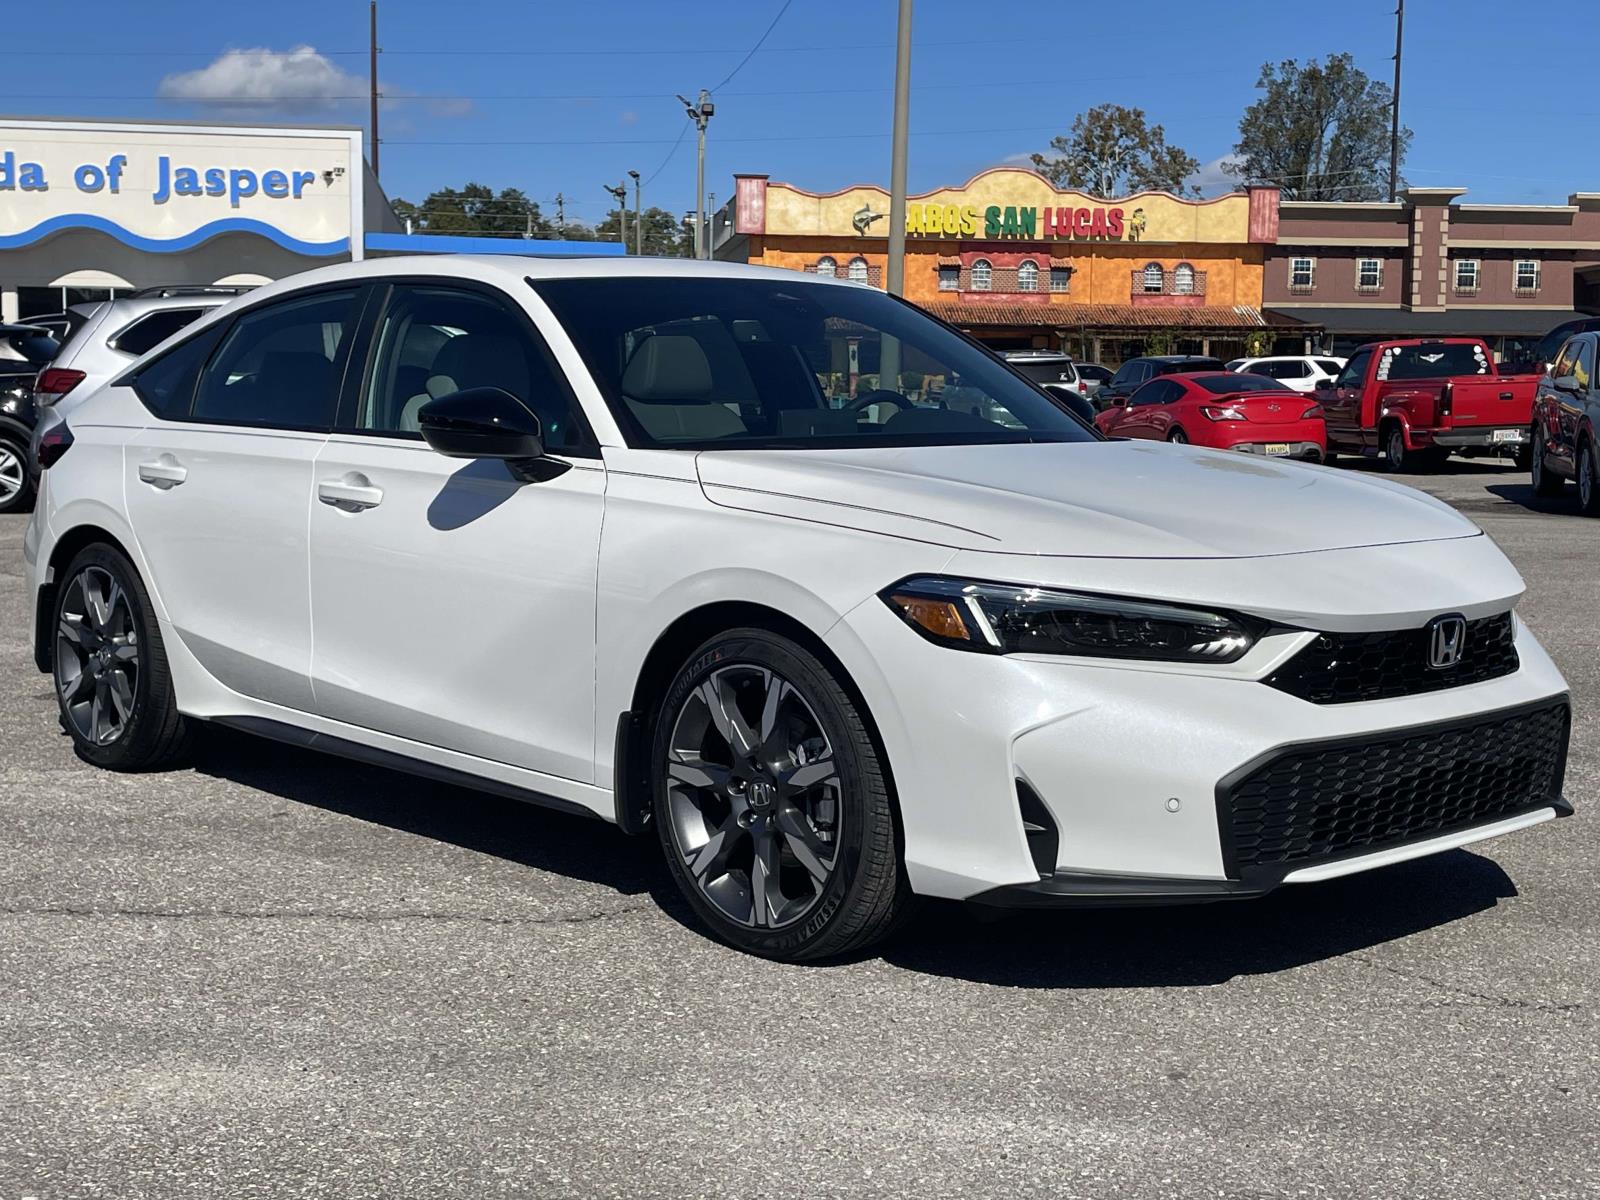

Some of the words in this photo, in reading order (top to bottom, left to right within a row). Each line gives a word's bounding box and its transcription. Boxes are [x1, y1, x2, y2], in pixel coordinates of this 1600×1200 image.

[74, 155, 127, 194] of
[153, 156, 315, 208] Jasper
[906, 203, 977, 236] ABOS
[984, 206, 1037, 237] SAN
[1043, 207, 1124, 239] LUCAS
